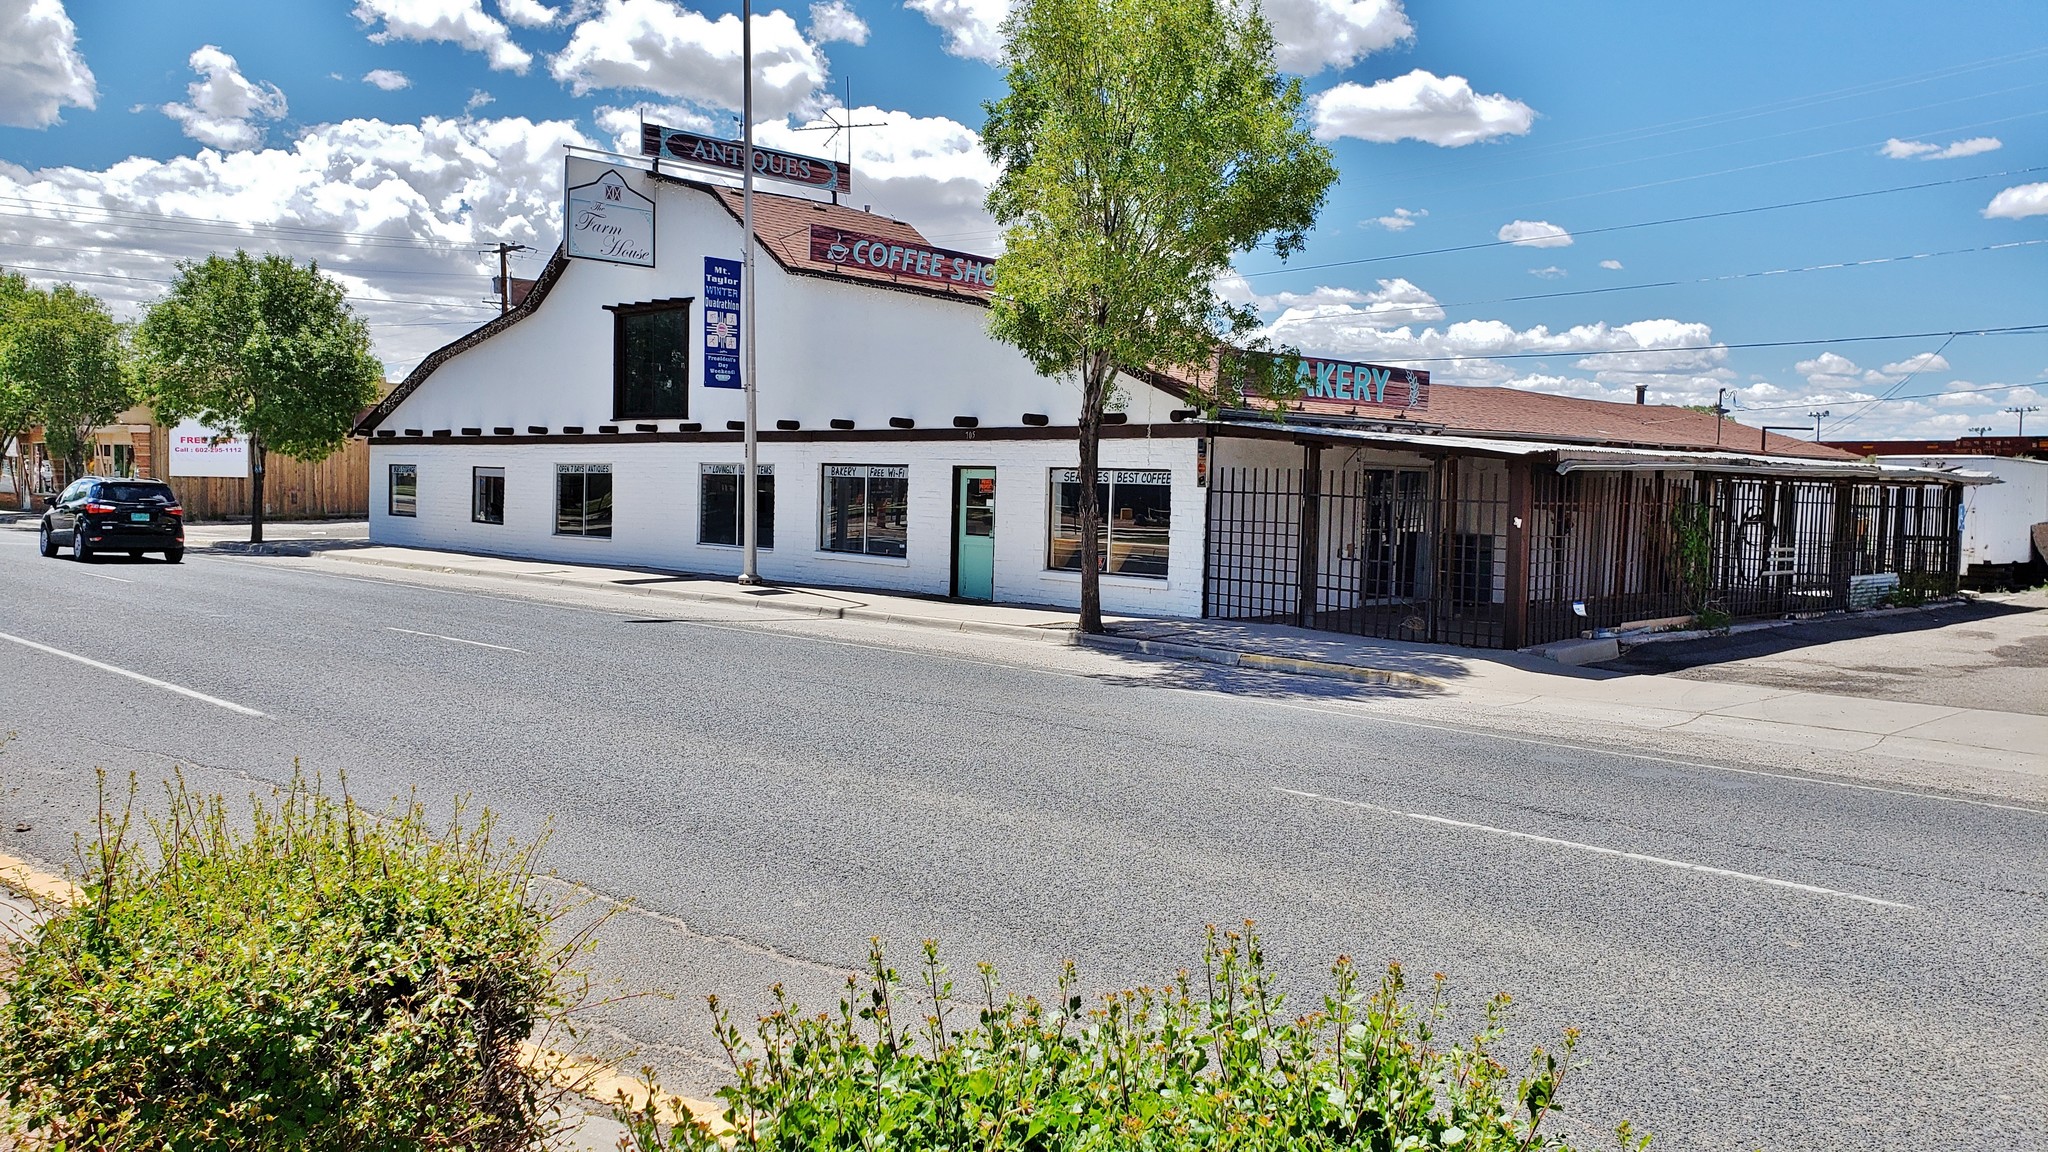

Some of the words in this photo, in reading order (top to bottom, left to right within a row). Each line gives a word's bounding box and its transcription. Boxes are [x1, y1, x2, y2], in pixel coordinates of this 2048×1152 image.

[691, 139, 812, 180] ANTQUES
[590, 201, 606, 212] The
[574, 209, 623, 236] Farm
[600, 235, 651, 261] House
[852, 239, 945, 278] COFFEE
[950, 259, 998, 287] SHO
[714, 266, 731, 276] Mt.
[705, 274, 739, 286] Taylor
[705, 285, 739, 298] WINTER
[558, 464, 570, 473] OPEN
[712, 465, 736, 474] LOVINGLY
[757, 465, 773, 475] TEMS
[831, 466, 857, 477] BAKERY
[869, 467, 885, 477] FREE
[888, 467, 905, 477] Wi-Fi
[1063, 471, 1109, 483] SEAES
[1116, 472, 1140, 484] BEST
[1141, 472, 1171, 485] COFFEE
